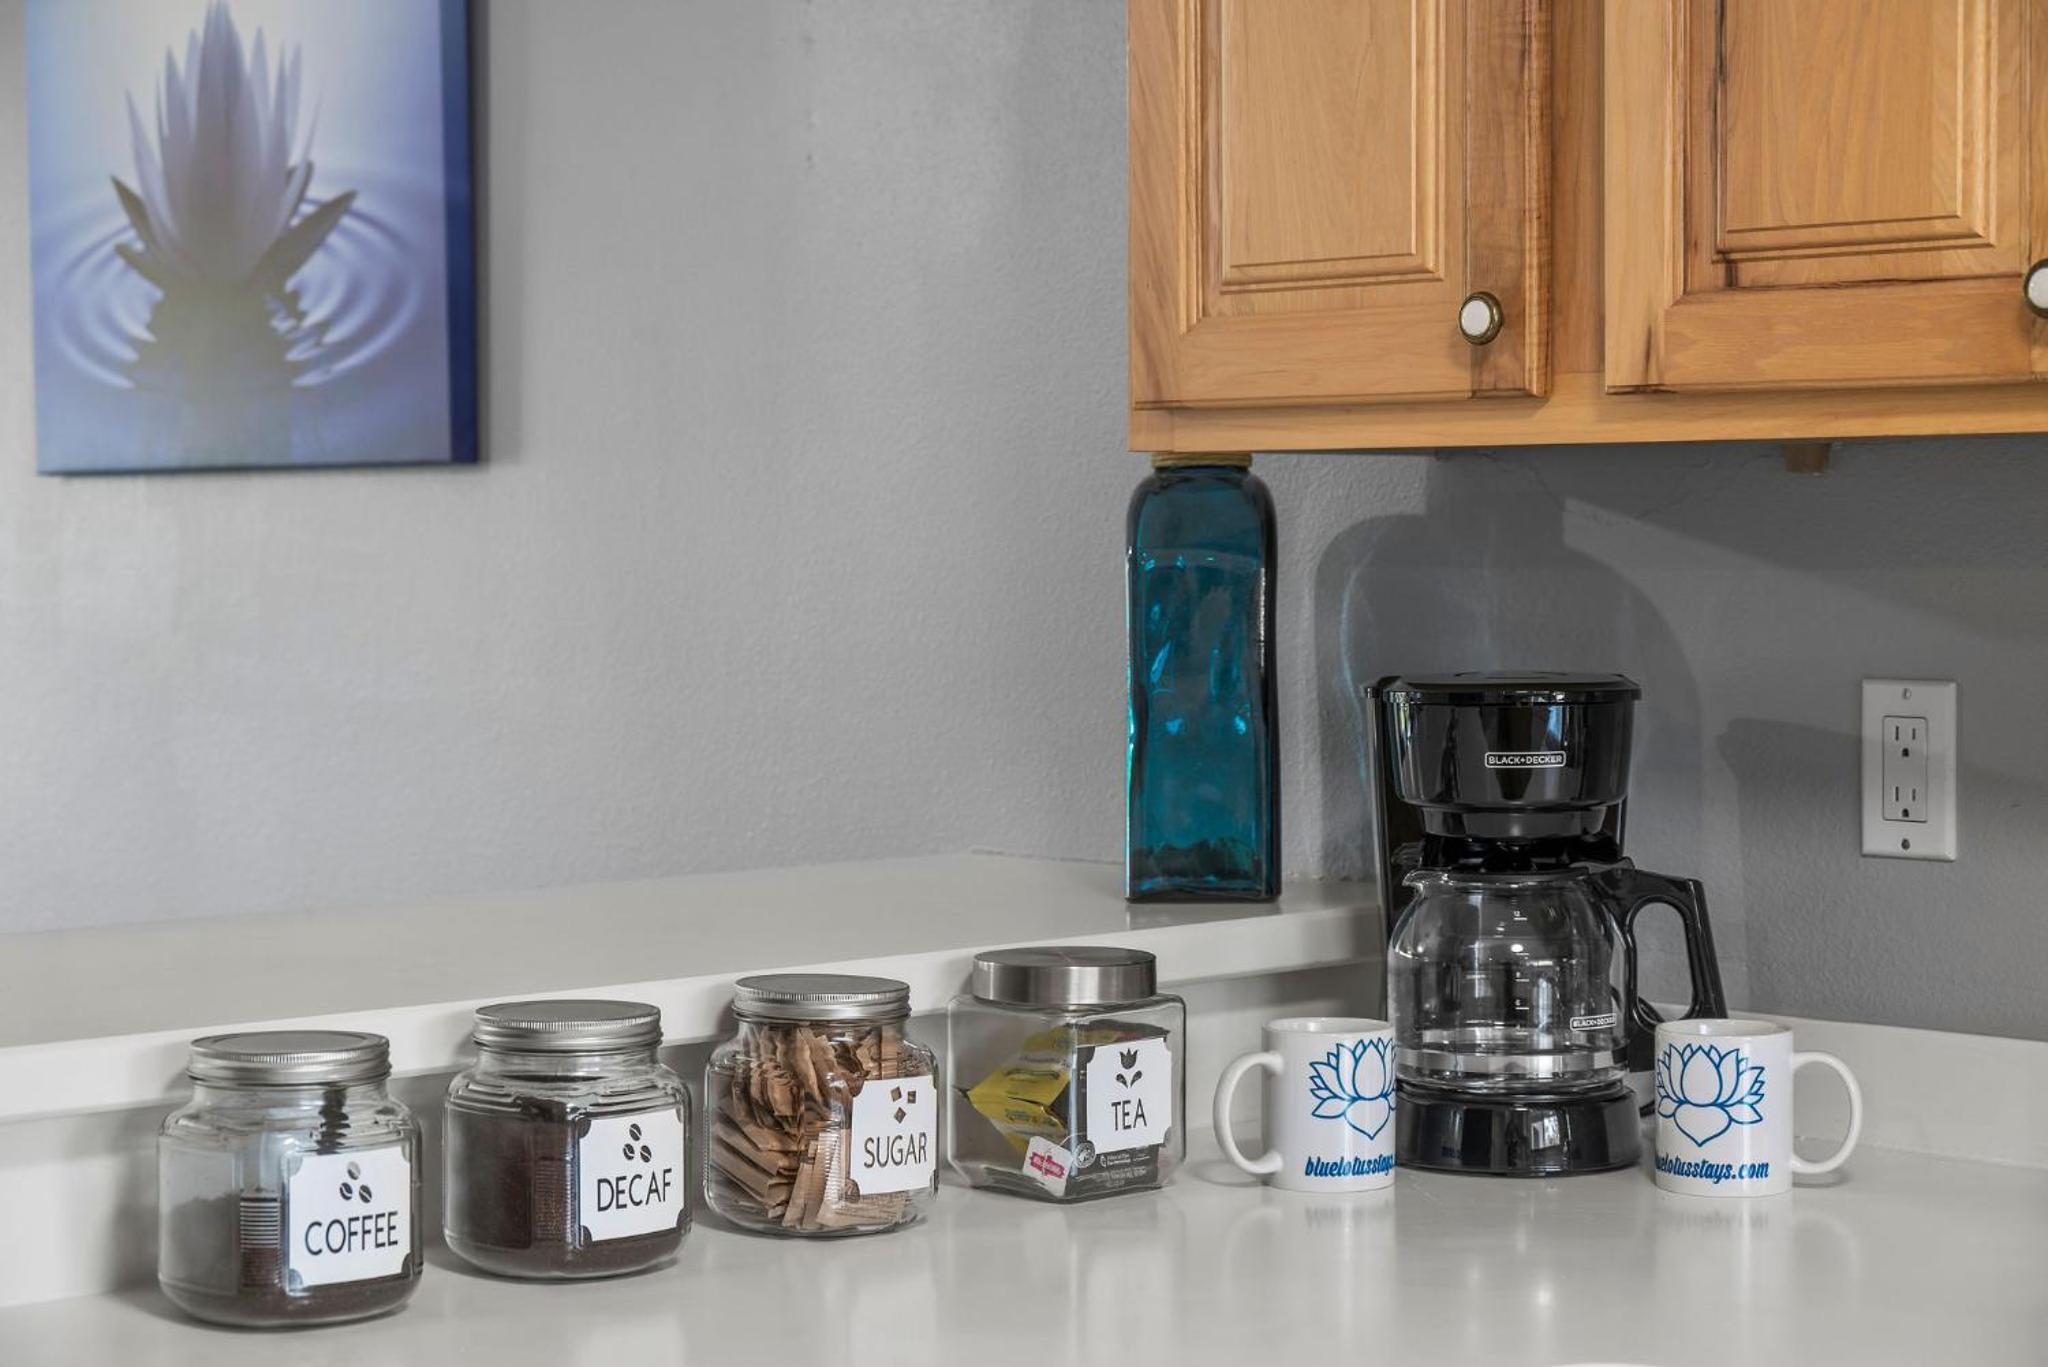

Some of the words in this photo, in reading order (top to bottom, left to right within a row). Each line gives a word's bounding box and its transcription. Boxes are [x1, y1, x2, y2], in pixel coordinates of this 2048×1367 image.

[1487, 755, 1563, 765] BLACK+DECKER
[1111, 1098, 1147, 1131] TEA
[864, 1131, 927, 1168] SUGAR
[597, 1167, 672, 1212] DECAF
[305, 1210, 398, 1256] COFFEE
